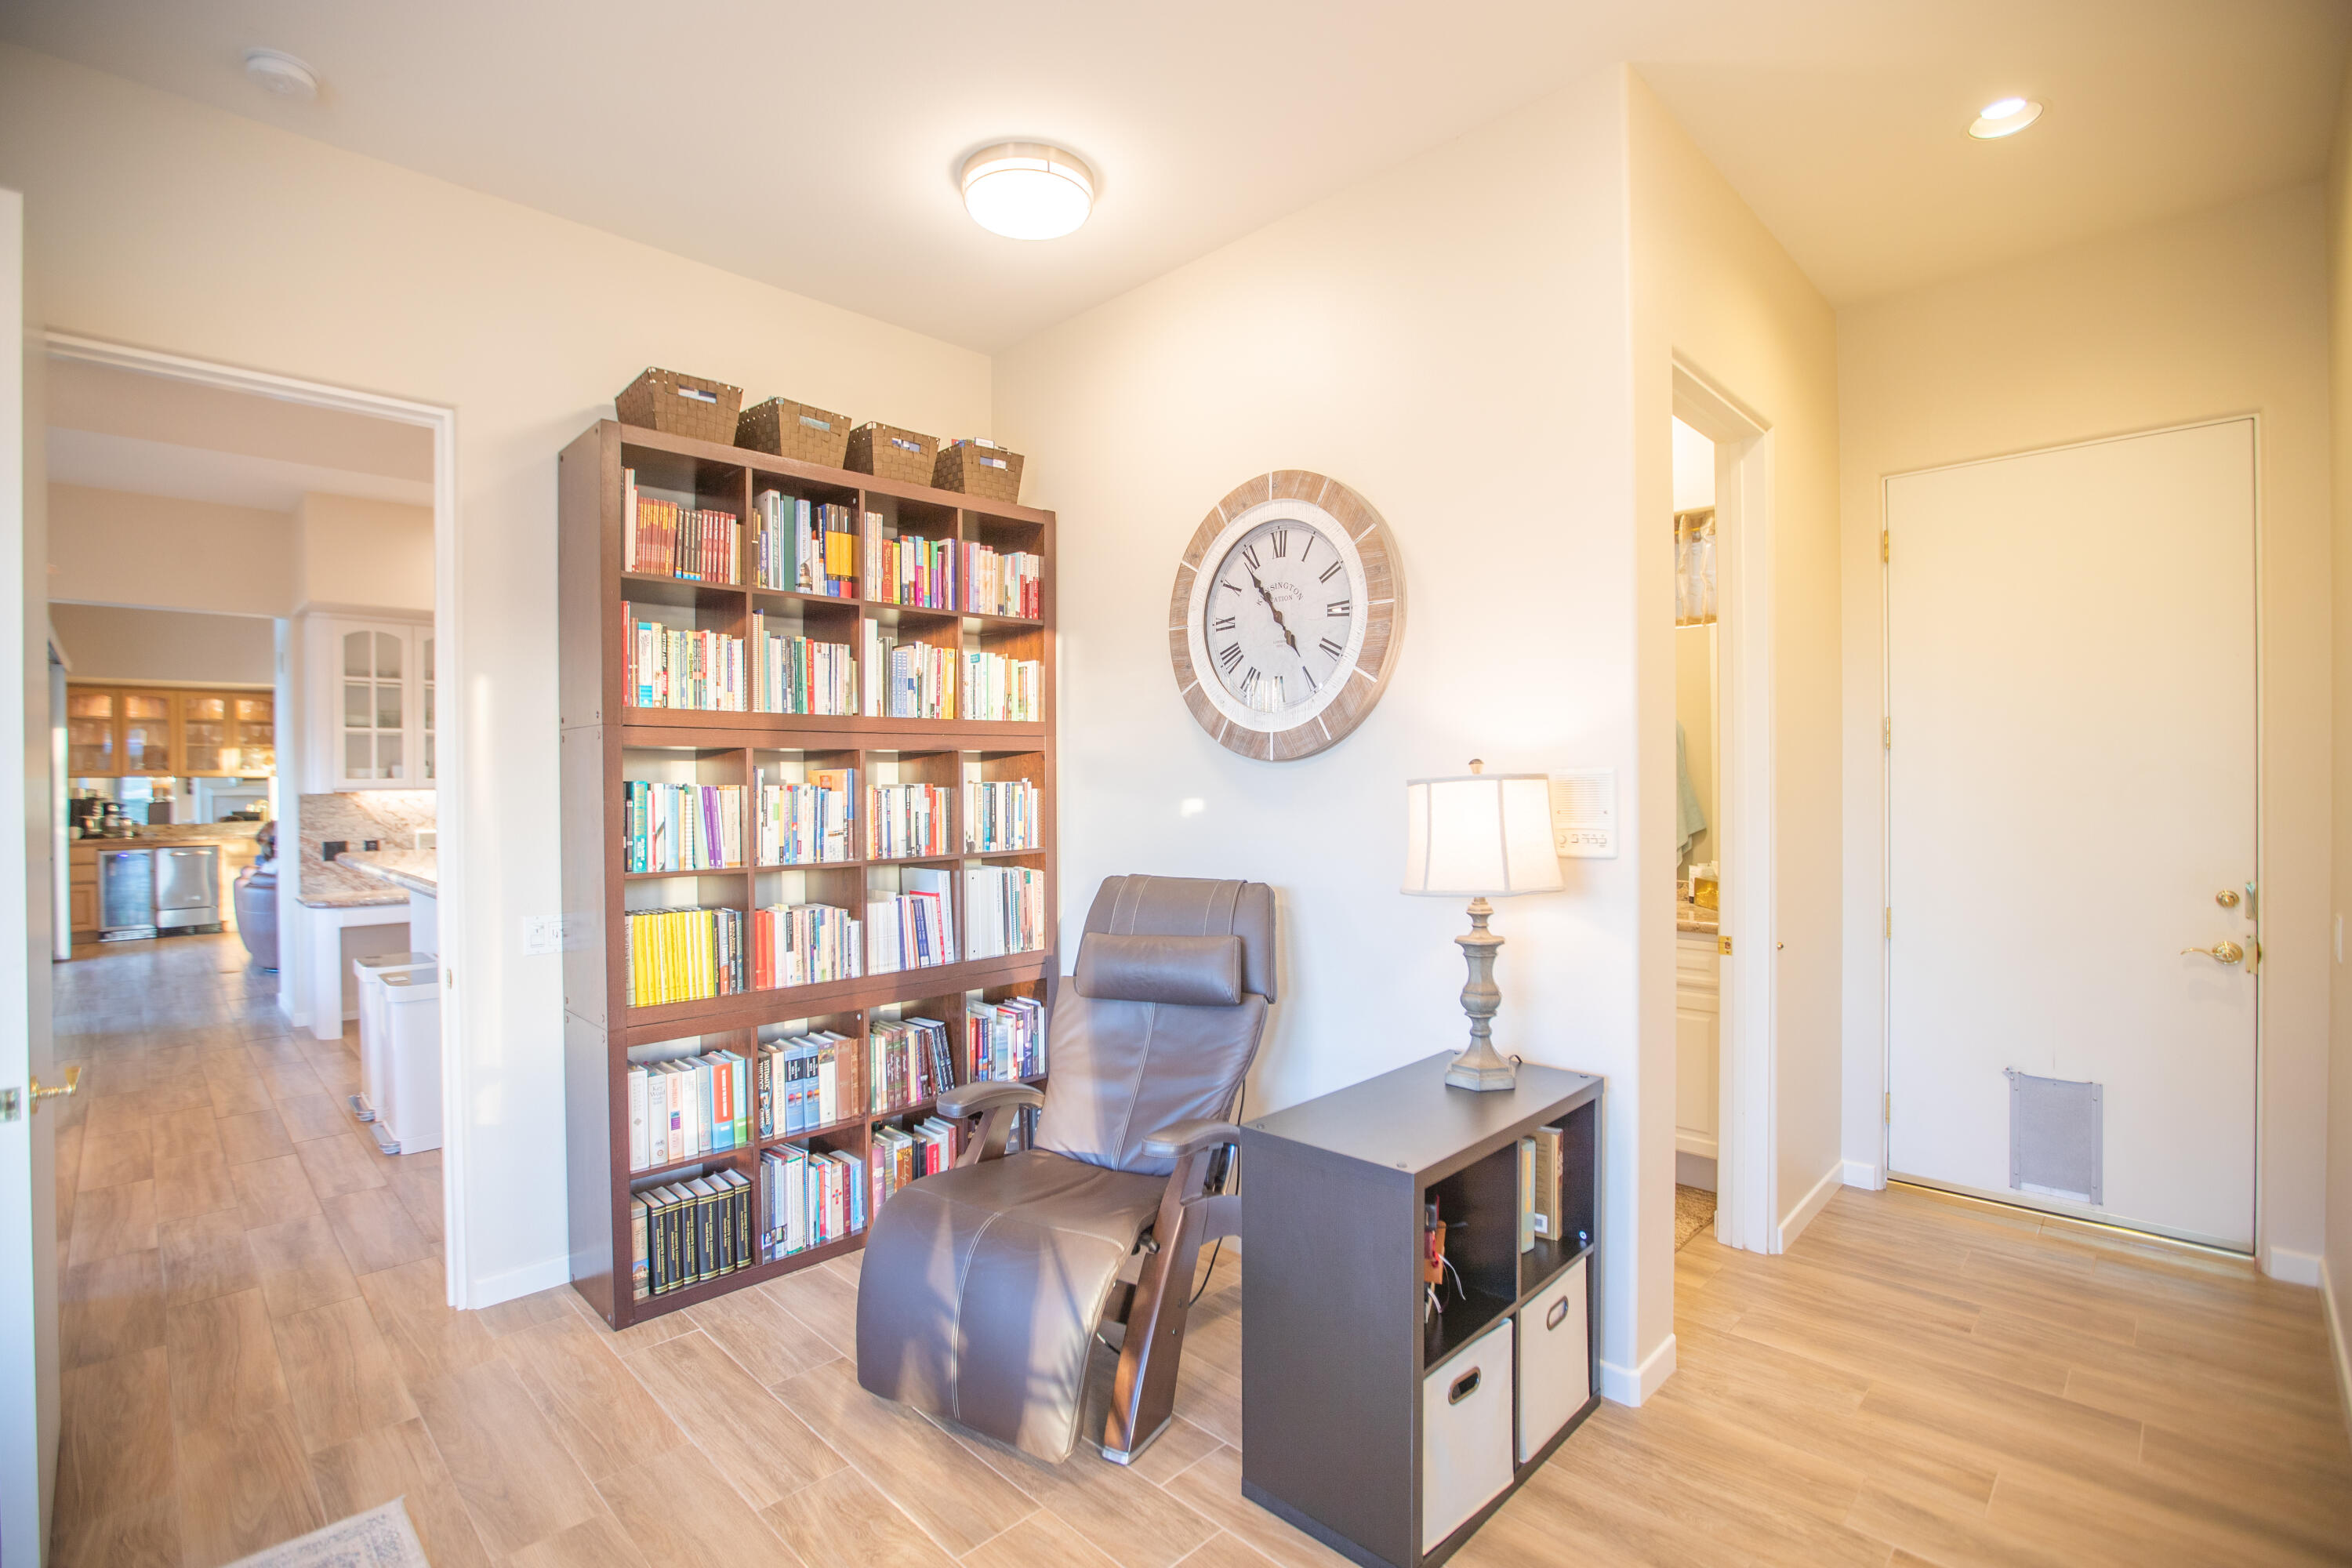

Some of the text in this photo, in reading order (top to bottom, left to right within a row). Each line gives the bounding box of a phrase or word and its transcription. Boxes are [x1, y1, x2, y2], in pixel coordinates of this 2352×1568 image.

[1271, 529, 1287, 559] XII
[1243, 544, 1261, 572] XI
[1319, 560, 1342, 585] II
[1222, 579, 1243, 596] X
[1270, 594, 1294, 603] TATION
[1327, 599, 1350, 617] III
